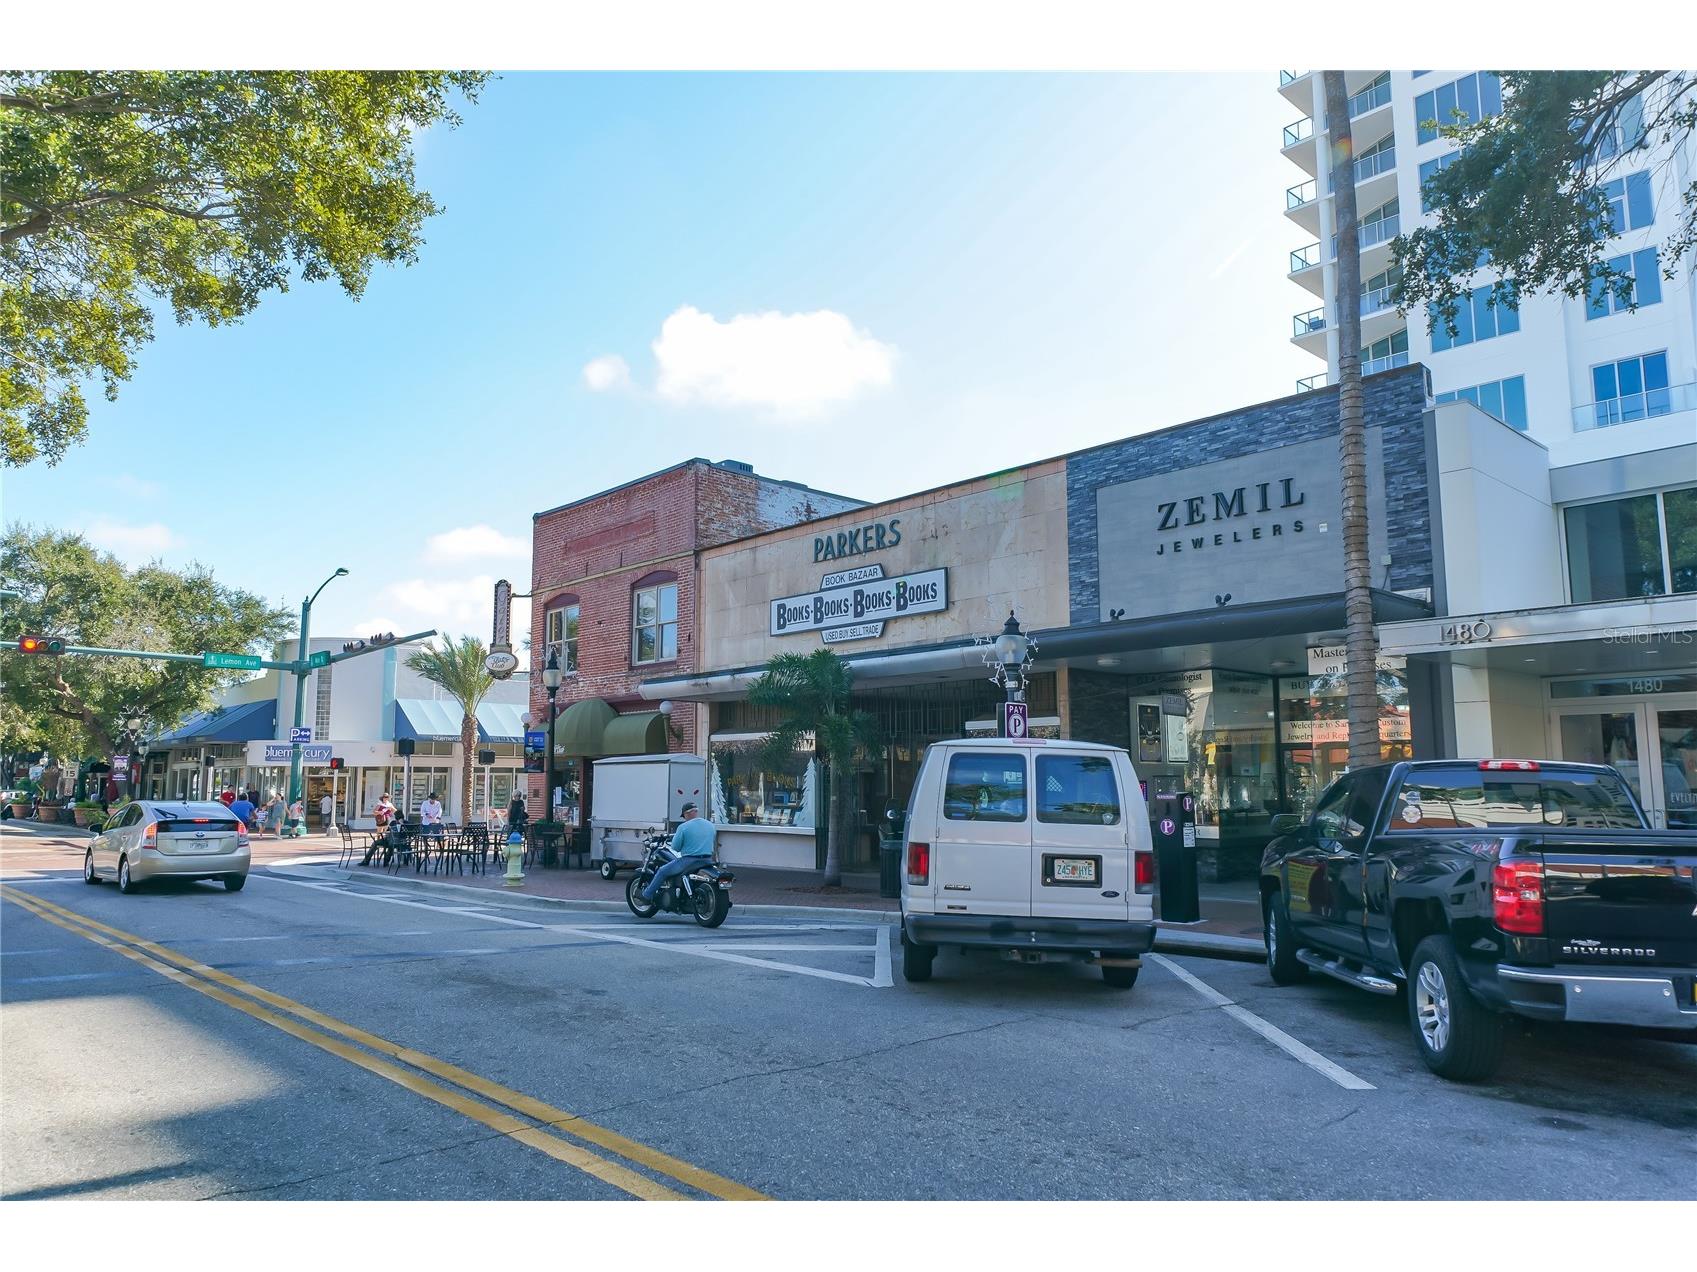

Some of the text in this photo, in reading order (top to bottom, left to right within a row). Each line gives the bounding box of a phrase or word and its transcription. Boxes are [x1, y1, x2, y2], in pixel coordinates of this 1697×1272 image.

[1157, 477, 1304, 531] ZEMIL
[813, 519, 902, 562] PARKERS
[1156, 520, 1304, 555] JEWELERS
[825, 567, 878, 586] BOOK BAZAAR
[1440, 621, 1492, 642] 1480
[1312, 647, 1347, 659] Maste
[221, 657, 257, 667] Lemon Ave
[1325, 665, 1339, 673] on
[1627, 679, 1663, 693] 1480
[1009, 704, 1024, 714] PAY
[1325, 721, 1333, 729] to
[264, 746, 331, 759] bluemcury
[1562, 945, 1656, 957] SILVERADO
